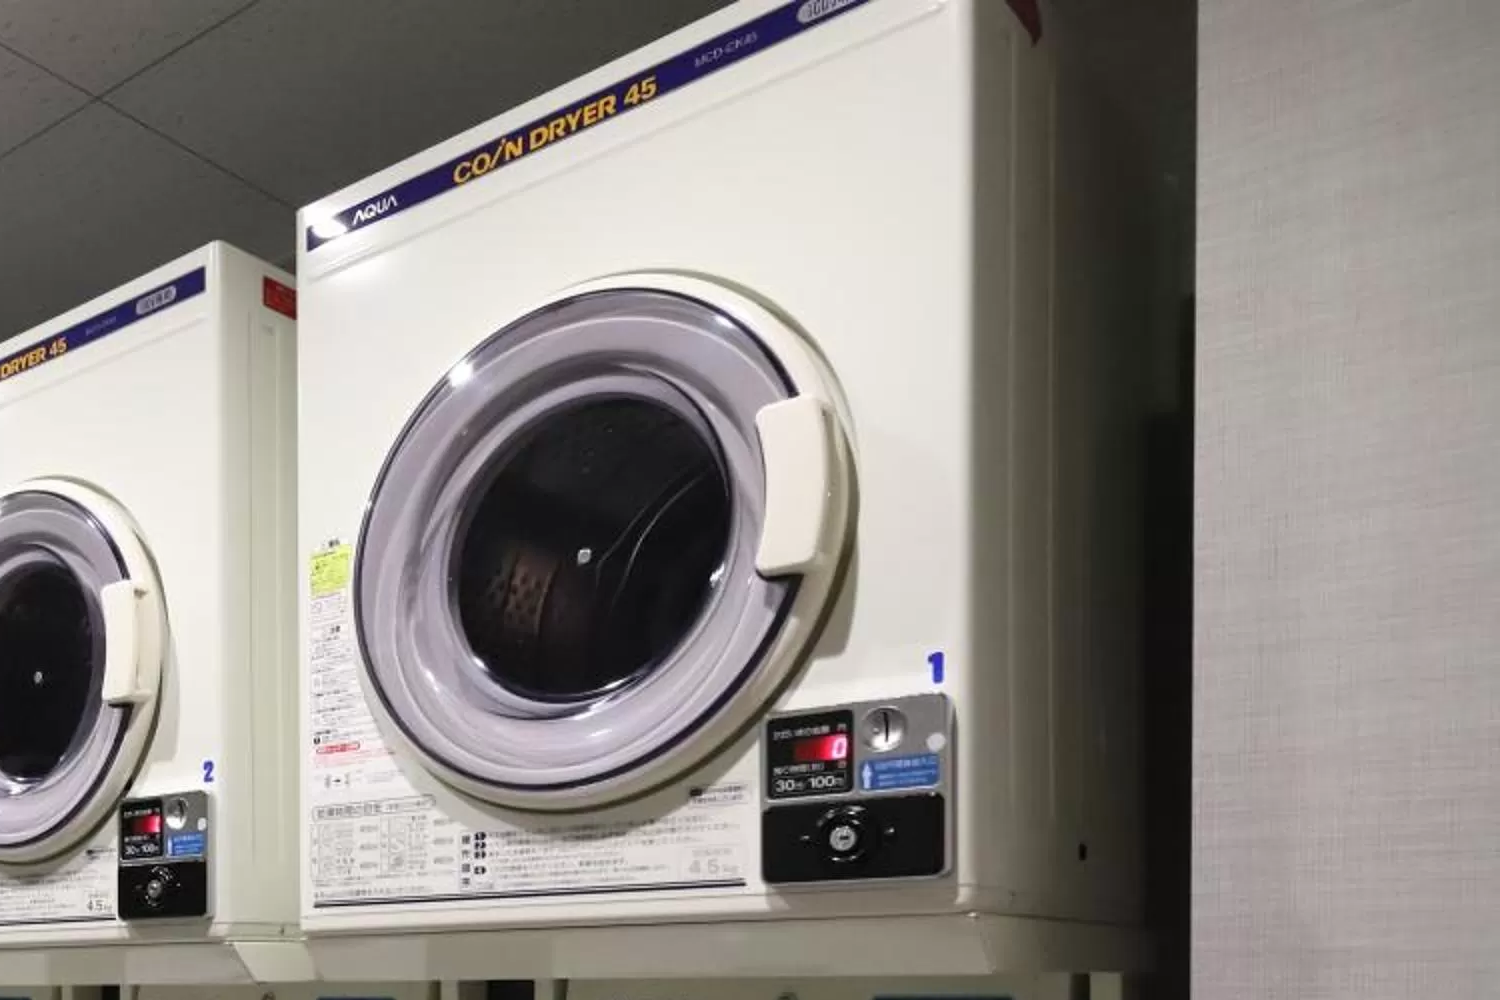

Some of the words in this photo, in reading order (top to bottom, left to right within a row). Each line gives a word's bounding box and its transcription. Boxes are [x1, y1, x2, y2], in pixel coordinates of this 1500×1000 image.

[353, 194, 398, 226] AQUA
[529, 93, 617, 151] DRYER
[624, 76, 658, 106] 45
[0, 347, 46, 380] DRYER
[49, 338, 68, 357] 45
[927, 651, 945, 684] 1
[203, 760, 215, 783] 2
